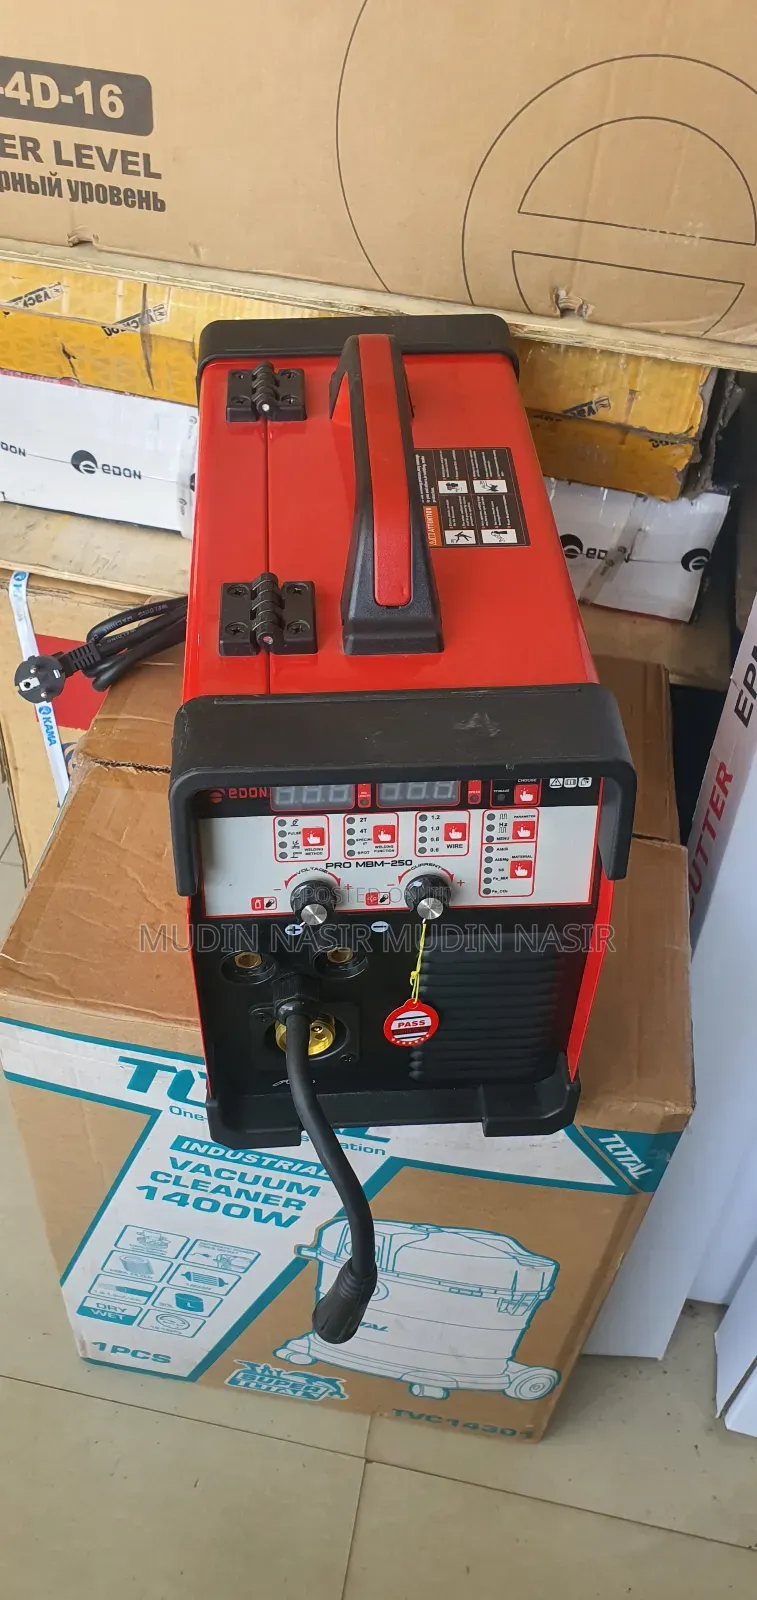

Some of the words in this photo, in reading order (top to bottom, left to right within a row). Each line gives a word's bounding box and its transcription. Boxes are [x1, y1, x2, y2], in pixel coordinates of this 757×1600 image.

[53, 140, 162, 179] LEVEL
[67, 179, 166, 212] уровень
[42, 716, 57, 746] KAMA
[296, 866, 328, 875] VOLTAGE
[325, 861, 352, 869] PRO
[355, 859, 413, 868] MBM-250
[411, 862, 442, 871] CURRENT
[397, 1019, 426, 1028] PASS
[339, 1141, 386, 1156] ation
[599, 1133, 655, 1180] TOTAL
[169, 1156, 321, 1198] VACUUM
[149, 1170, 307, 1212] CLEANER
[135, 1185, 301, 1229] 1400W
[90, 1309, 124, 1321] WET
[95, 1302, 127, 1313] DRY
[91, 1341, 172, 1364] 1PCS
[236, 1372, 330, 1396] SUPER
[392, 1407, 537, 1440] TVC14301
